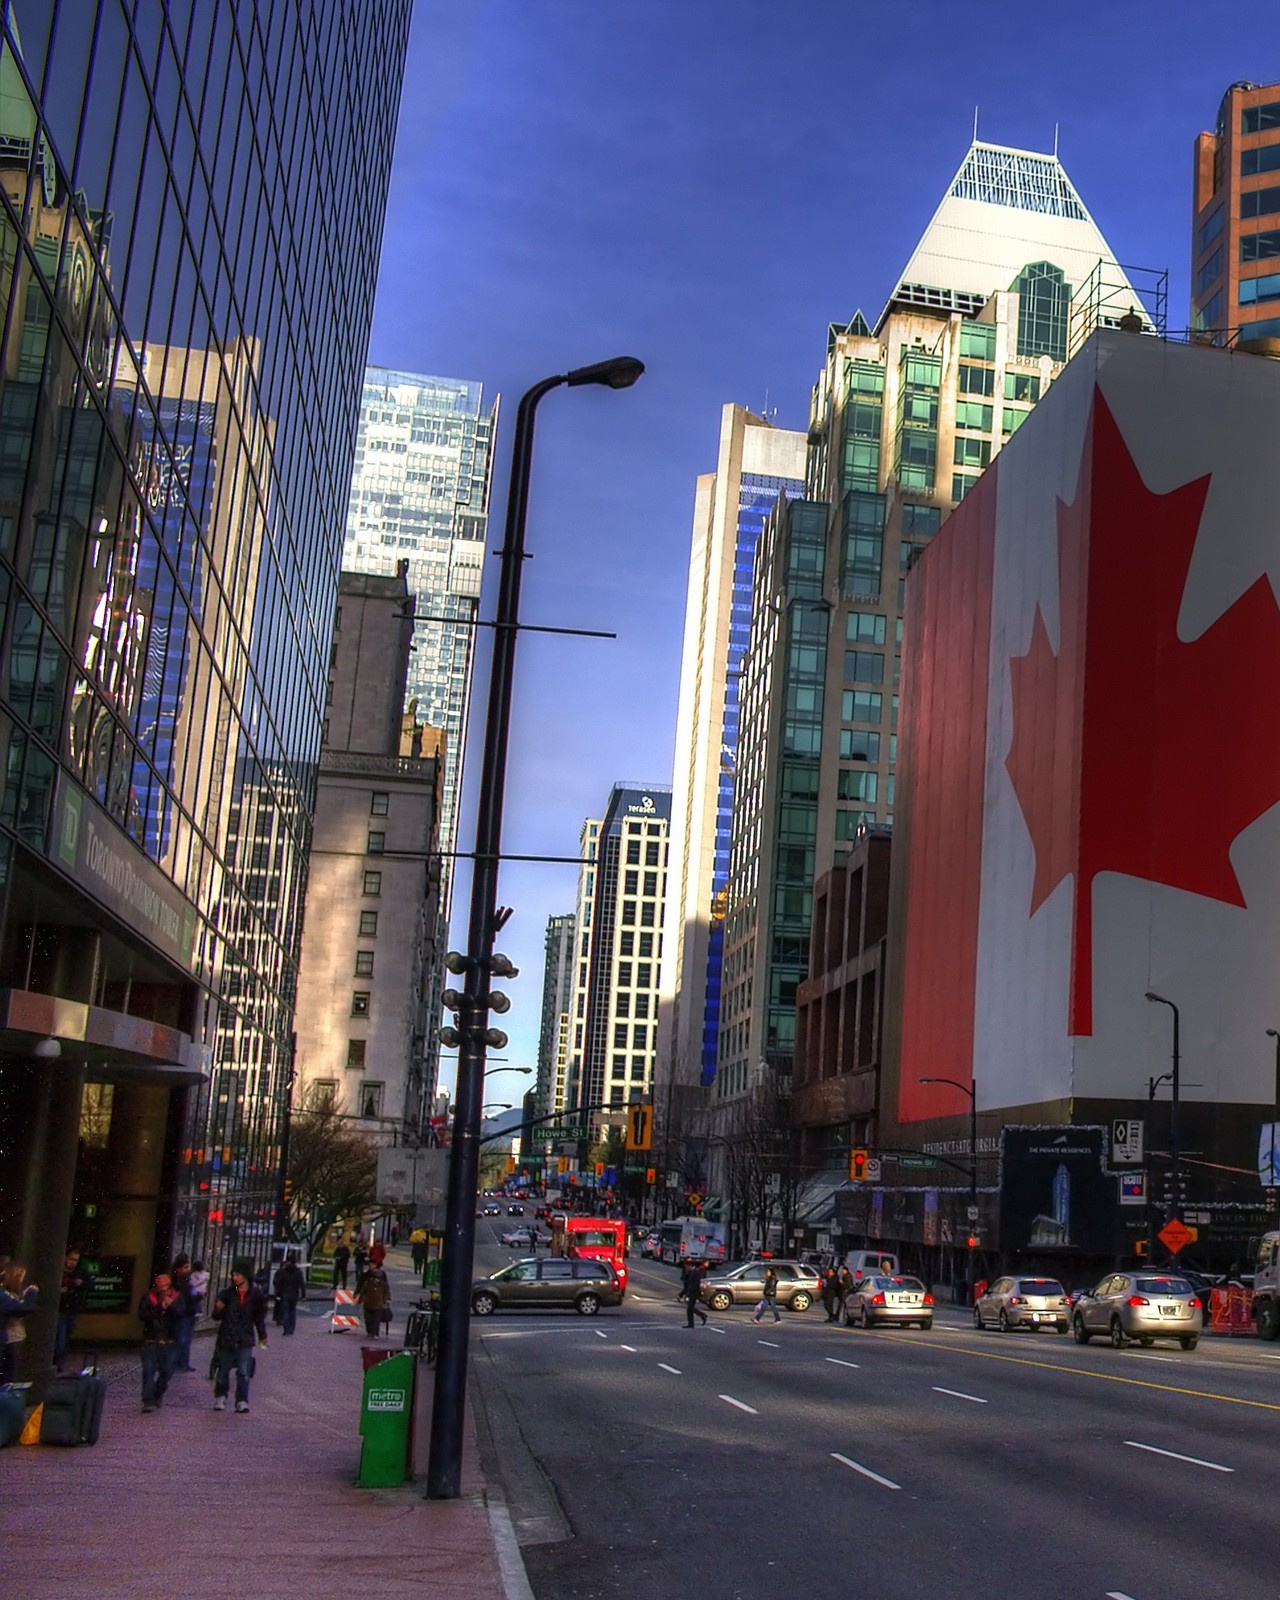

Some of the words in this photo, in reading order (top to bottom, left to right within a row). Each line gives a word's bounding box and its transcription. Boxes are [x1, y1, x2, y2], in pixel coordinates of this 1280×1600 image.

[65, 803, 78, 848] TD
[86, 821, 125, 894] TORONTO
[537, 1129, 567, 1138] Howe
[572, 1128, 583, 1137] St
